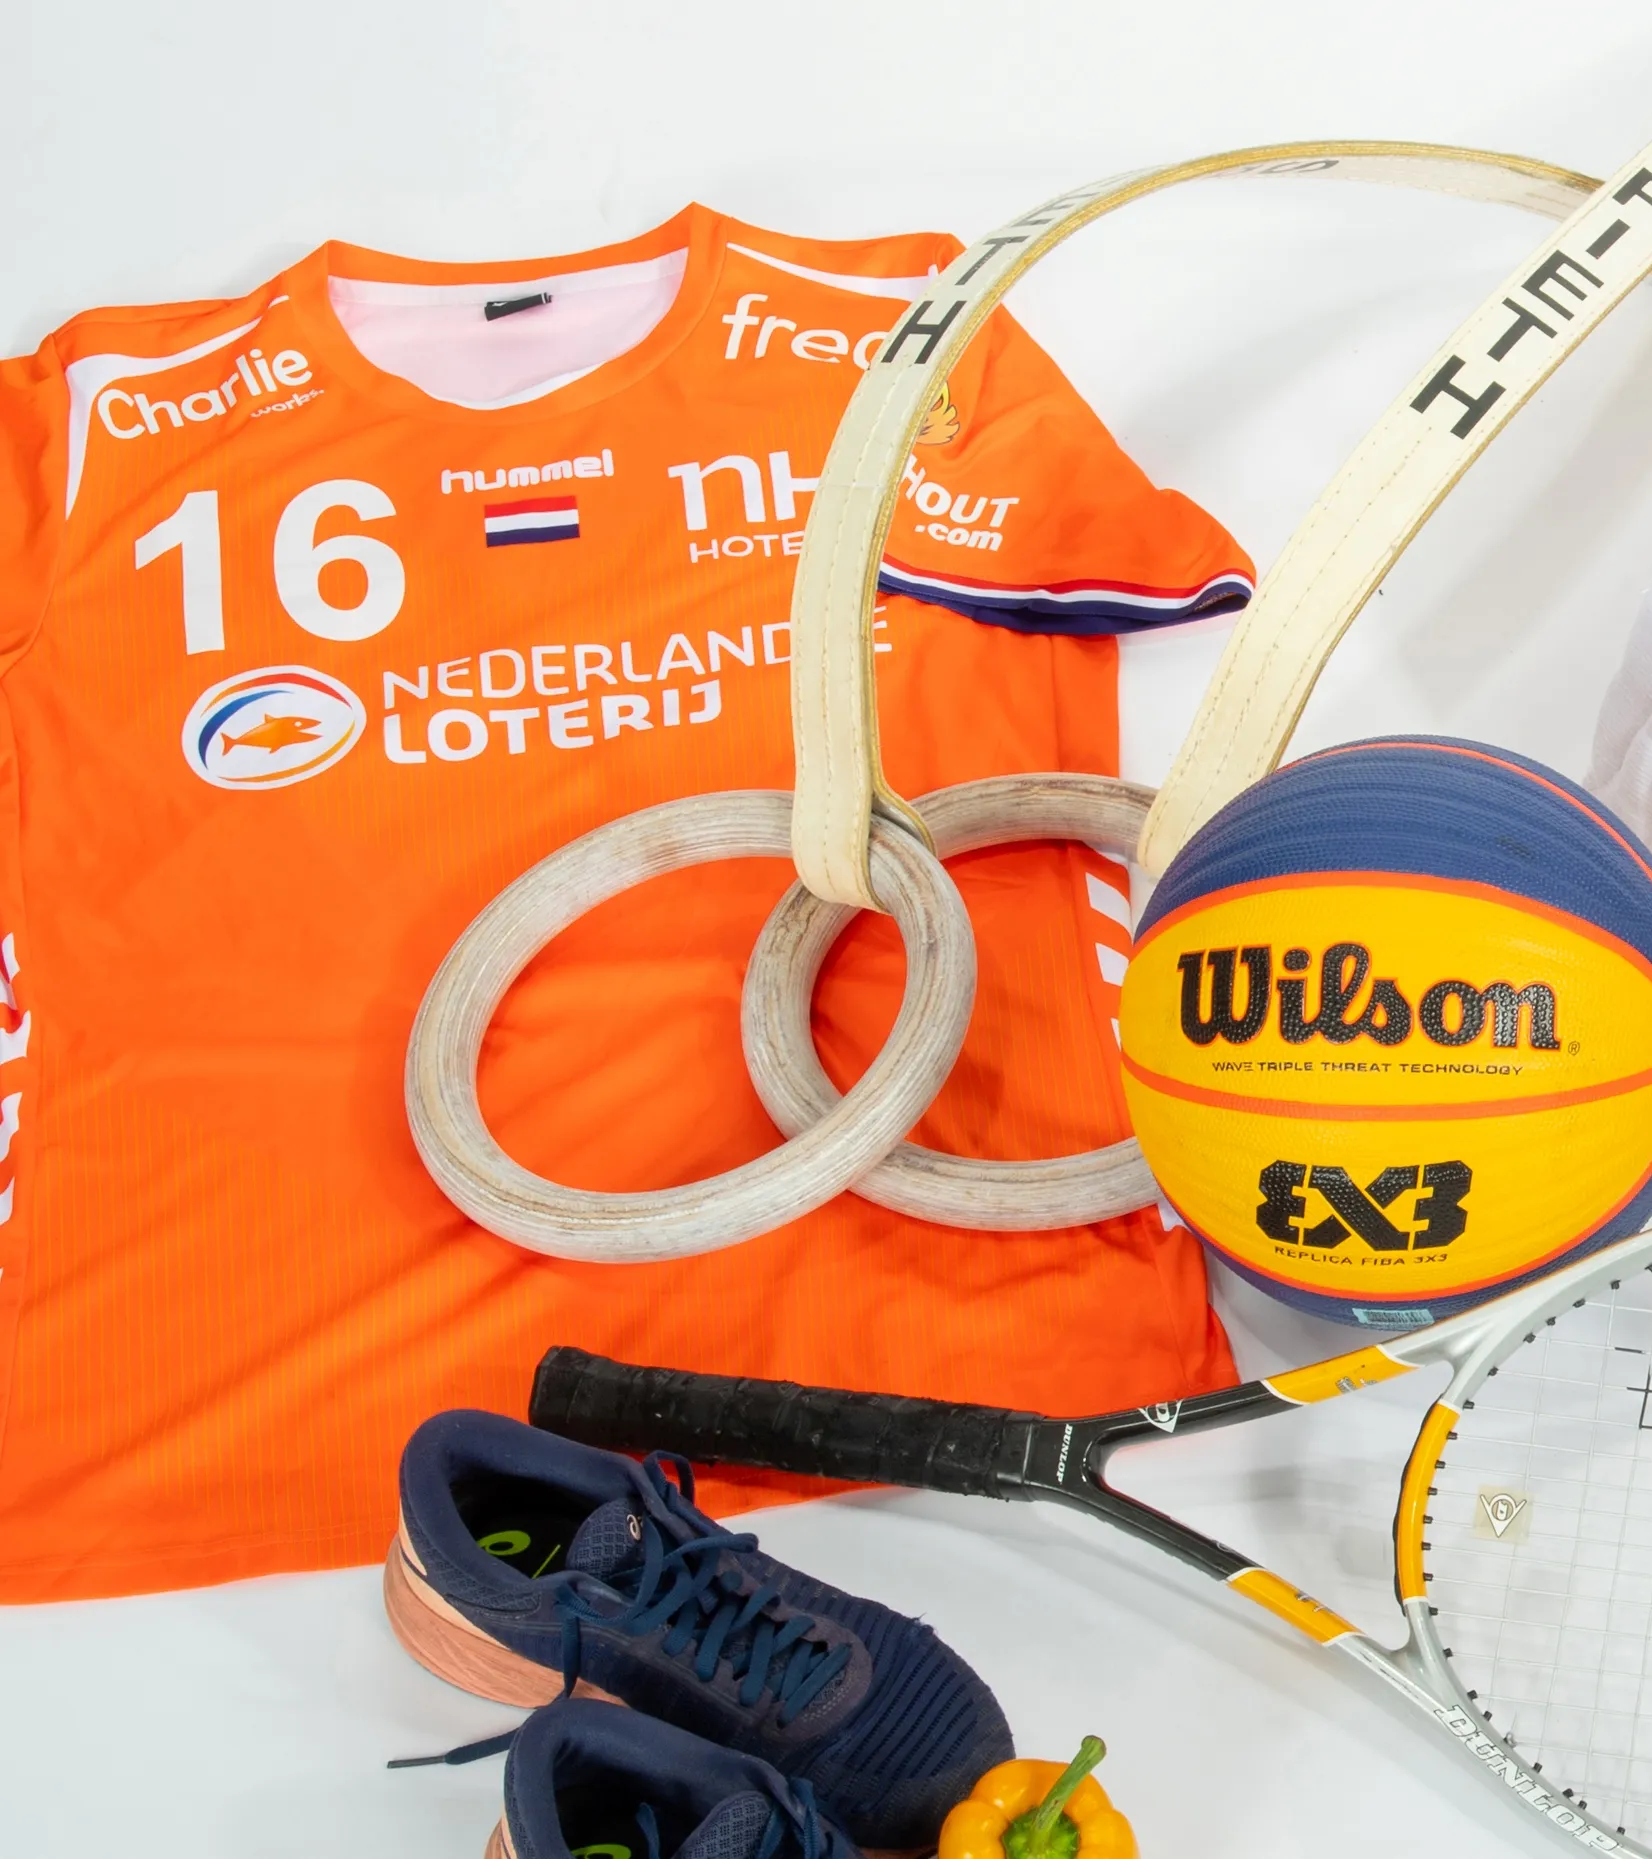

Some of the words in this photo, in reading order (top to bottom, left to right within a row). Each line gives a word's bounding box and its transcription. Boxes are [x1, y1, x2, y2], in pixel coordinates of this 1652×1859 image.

[97, 348, 314, 440] Charlie
[440, 448, 615, 496] hummel
[134, 478, 407, 657] 16
[914, 522, 1004, 553] .com
[383, 679, 723, 766] LOTERIJ
[1175, 941, 1562, 1051] Wilson
[1211, 1061, 1254, 1073] WAVE
[1256, 1061, 1314, 1073] TRIPLE
[1320, 1061, 1393, 1074] THREAT
[1399, 1063, 1524, 1076] TECHNOLOGY
[1273, 1245, 1353, 1266] REPLICA
[1360, 1257, 1406, 1267] FIBA
[1412, 1252, 1449, 1265] 3X3
[1056, 1423, 1074, 1485] DUNLOP
[1432, 1703, 1623, 1852] DUNLOP
